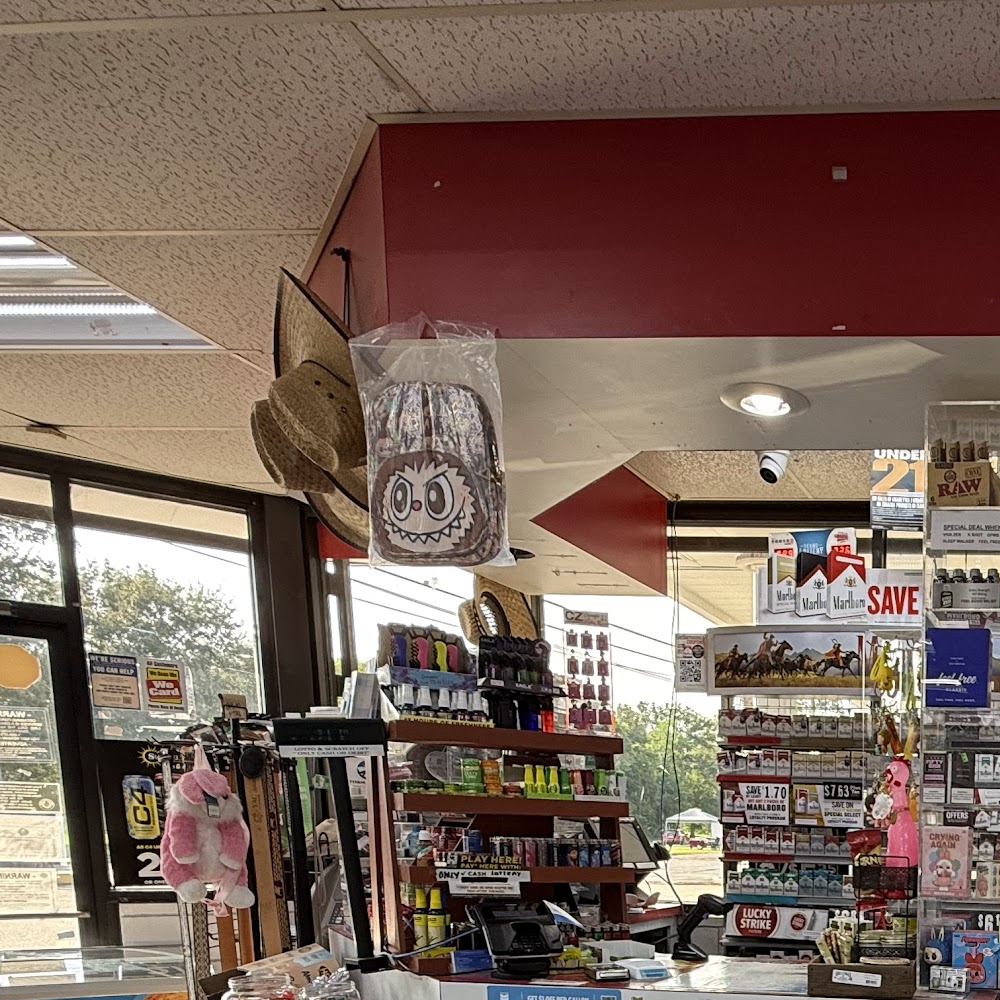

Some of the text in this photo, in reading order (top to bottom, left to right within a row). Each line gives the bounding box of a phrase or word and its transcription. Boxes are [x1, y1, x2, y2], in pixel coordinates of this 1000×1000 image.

[872, 459, 924, 492] 21
[937, 478, 982, 497] RAW
[943, 524, 967, 532] SPECIAL
[968, 524, 983, 532] DEAL
[868, 586, 919, 615] SAVE
[152, 681, 174, 689] We
[149, 688, 180, 696] Card
[746, 786, 761, 795] SAVE
[747, 804, 786, 812] MARLBORO
[461, 855, 522, 864] PLAY HERE!
[439, 871, 459, 879] ONLY
[742, 908, 772, 919] LUCKY
[740, 918, 772, 930] STRIKE
